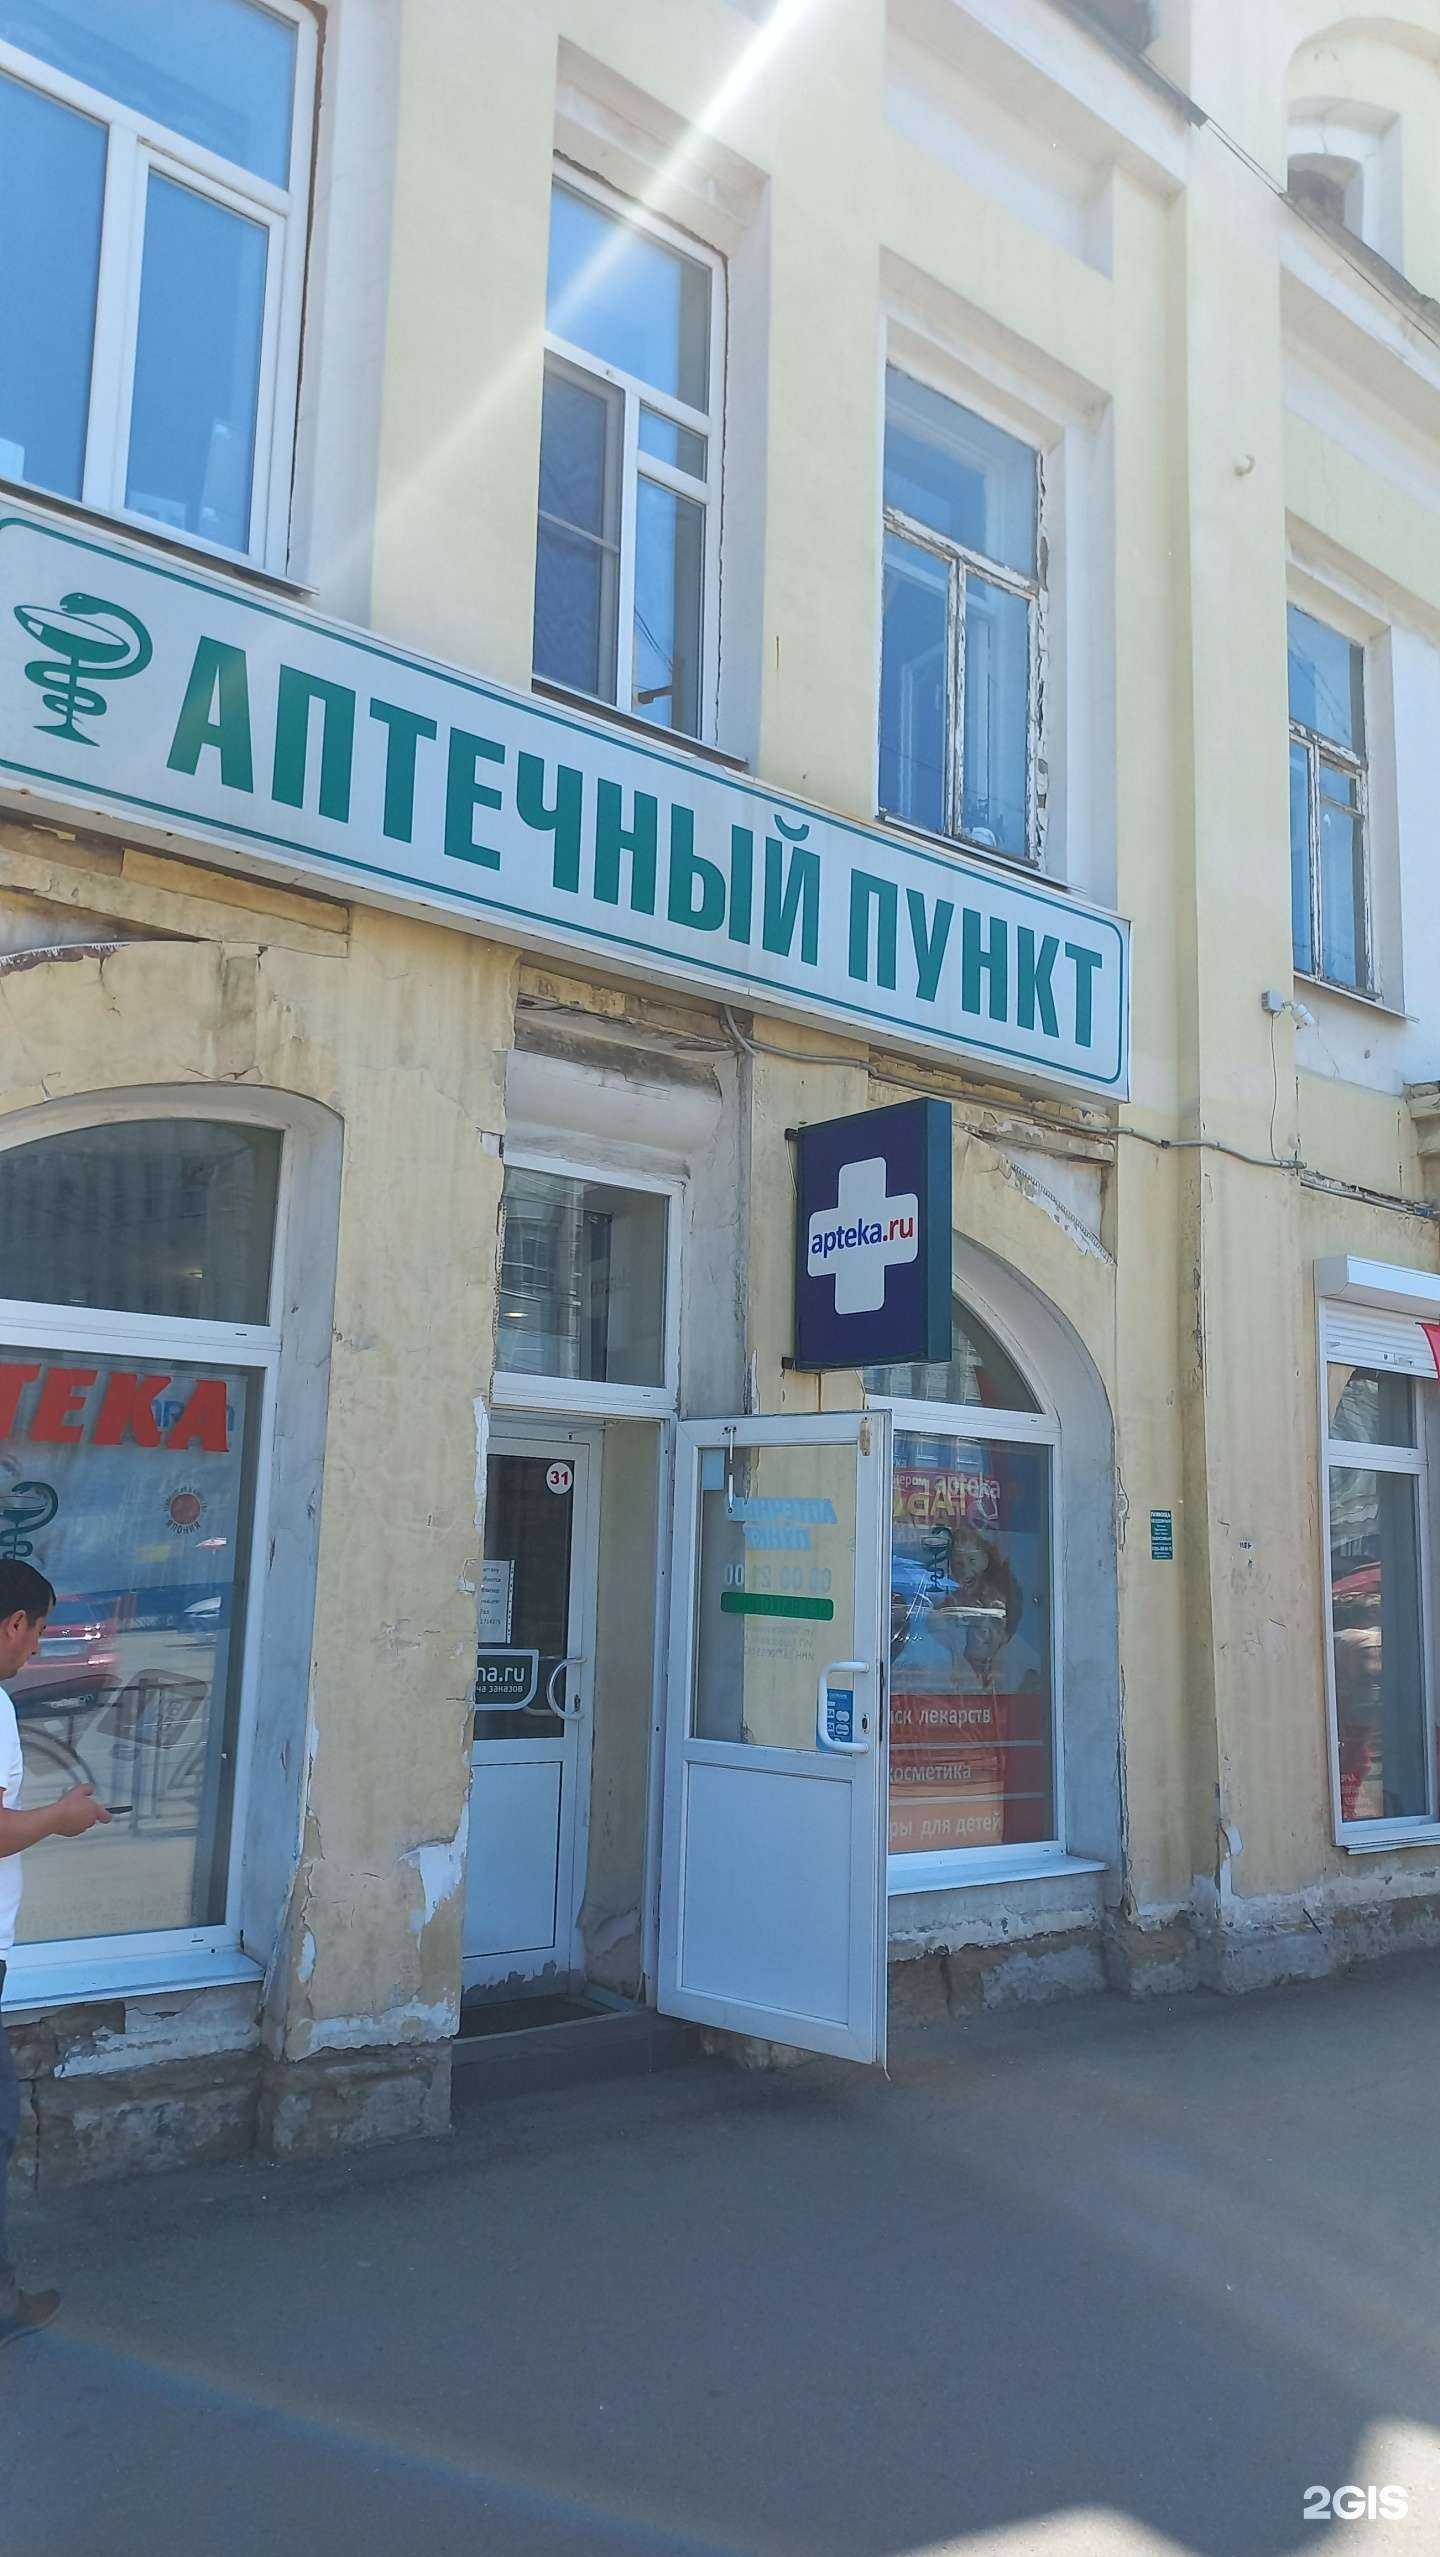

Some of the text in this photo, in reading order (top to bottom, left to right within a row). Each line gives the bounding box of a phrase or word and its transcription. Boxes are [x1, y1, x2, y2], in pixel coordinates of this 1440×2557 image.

[167, 635, 1102, 1048] АПТЕЧНЫЙ ПУНКТ
[811, 1216, 914, 1259] apteka.ru
[550, 1470, 569, 1485] 31
[489, 1685, 524, 1693] заказов
[919, 1707, 993, 1728] лекарств
[920, 1816, 950, 1840] для
[956, 1810, 1001, 1836] детей
